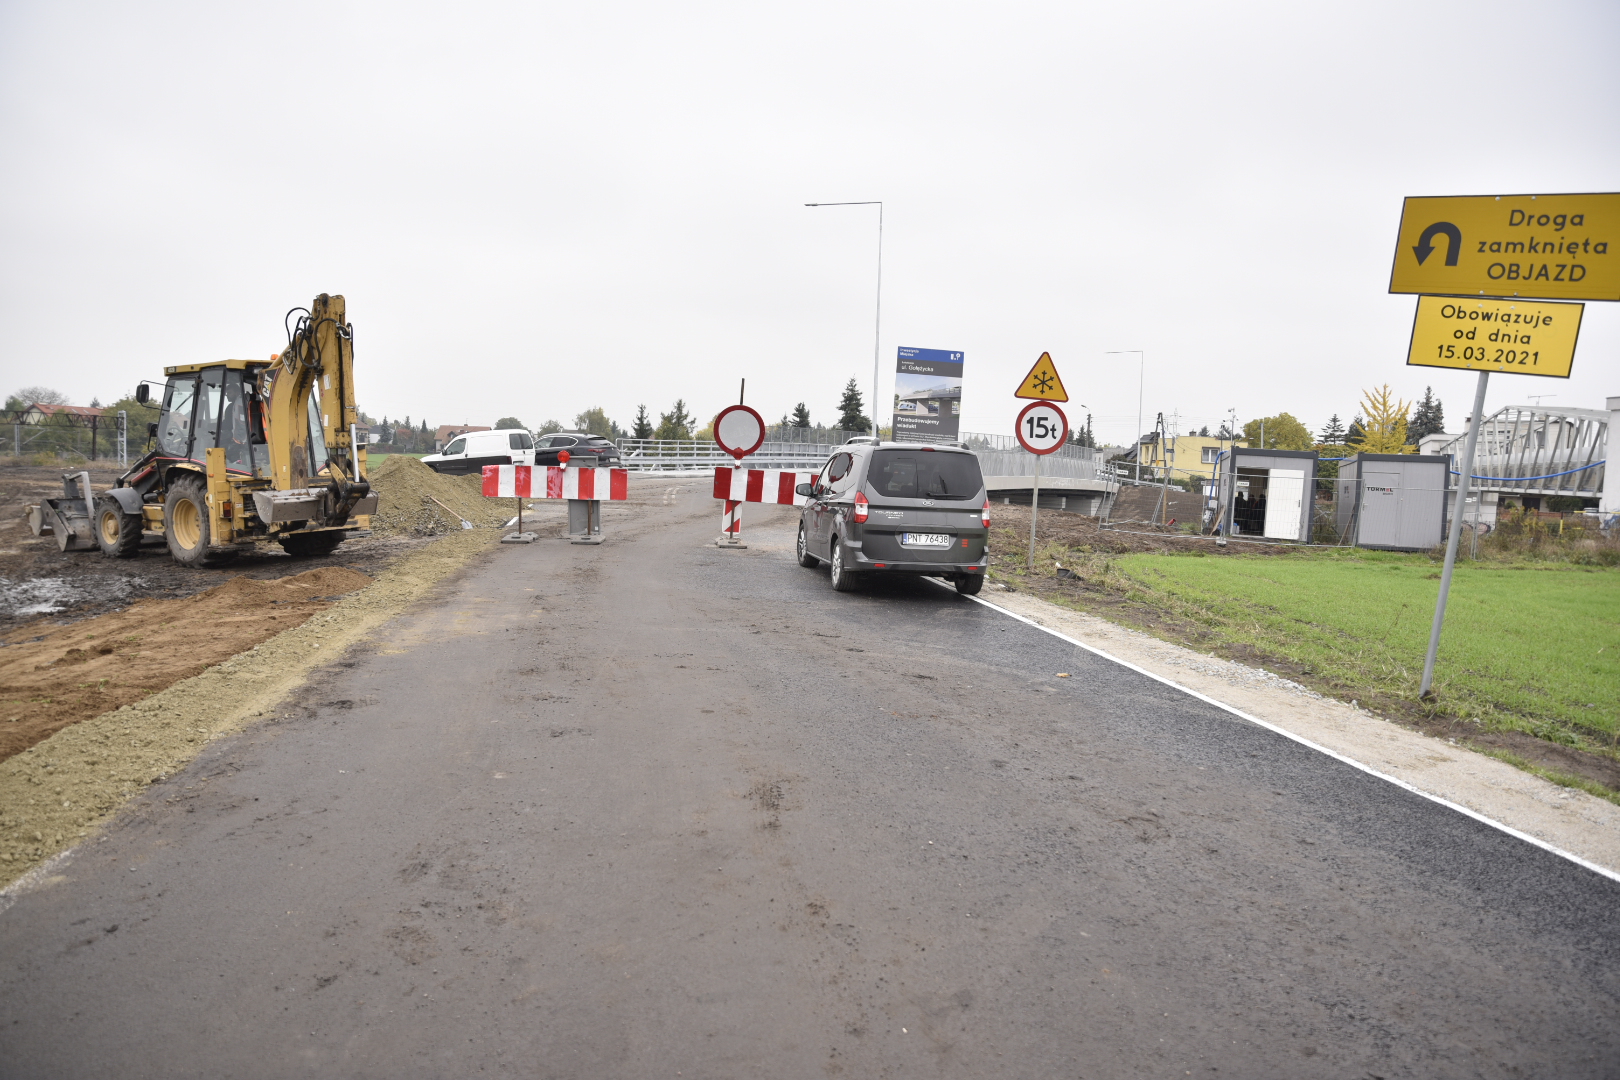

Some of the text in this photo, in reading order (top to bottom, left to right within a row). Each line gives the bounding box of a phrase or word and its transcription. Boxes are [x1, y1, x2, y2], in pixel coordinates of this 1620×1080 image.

[1508, 209, 1585, 232] Droga
[1477, 236, 1608, 260] zamknięta
[1487, 262, 1587, 282] OBJAZD
[1440, 304, 1553, 329] Obowiązuje
[1453, 327, 1531, 345] od dnia
[1437, 344, 1539, 366] 15.03.2021
[262, 374, 273, 397] CAT
[897, 417, 939, 425] Przebudowujemy
[1027, 417, 1057, 439] 15t
[908, 534, 948, 543] PNT 76438
